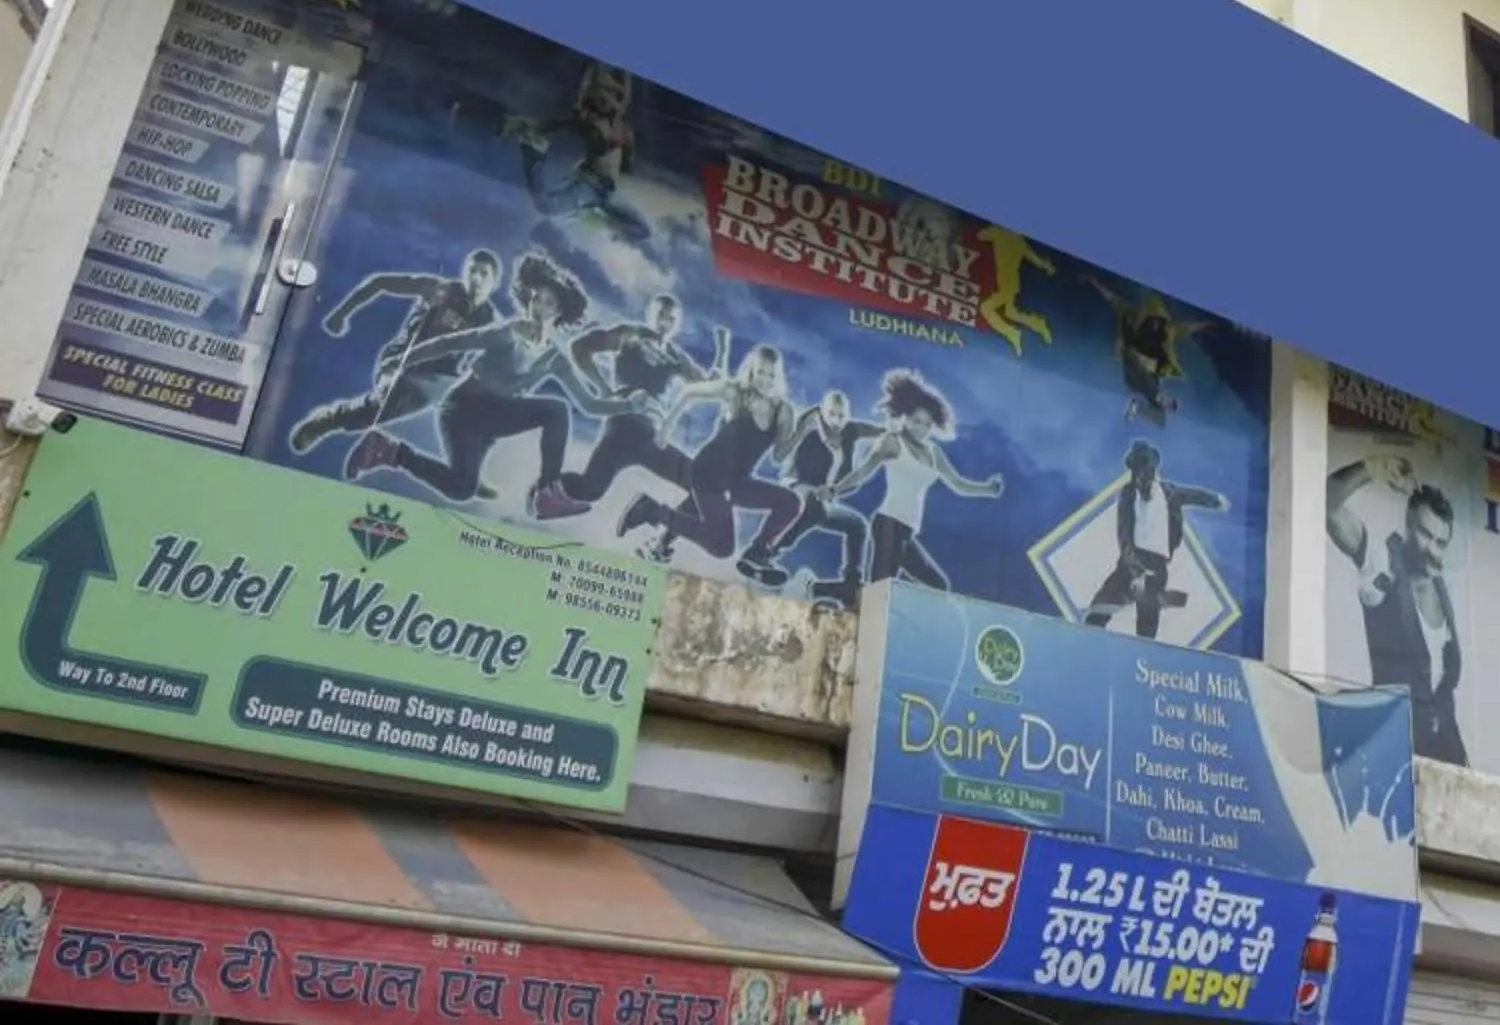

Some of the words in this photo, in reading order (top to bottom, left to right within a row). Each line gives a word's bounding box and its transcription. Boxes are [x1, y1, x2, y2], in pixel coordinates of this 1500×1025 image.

[124, 160, 182, 193] DANCING
[185, 177, 221, 204] SALSA
[113, 195, 171, 226] WESTERN
[167, 213, 215, 240] DANCE
[722, 153, 981, 279] BROADWAY
[101, 230, 131, 254] FREE
[130, 237, 168, 264] STYLE
[714, 211, 978, 327] INSTITUTE
[718, 186, 983, 307] DANCE
[88, 268, 138, 294] MASALA
[138, 279, 201, 312] BHANGRA
[73, 302, 127, 331] SPECIAL
[126, 318, 187, 351] AEROBICS
[187, 335, 199, 352] &
[199, 336, 247, 363] ZUMBA
[849, 307, 965, 348] LUDHIANA
[62, 345, 128, 374] SPECIAL
[132, 361, 194, 389] FITNESS
[195, 379, 244, 403] CLASS
[102, 374, 136, 394] FOR
[140, 383, 195, 408] LADIES
[137, 533, 294, 615] Hotel
[317, 572, 528, 676] Welcome
[550, 627, 629, 702] Inn
[58, 660, 92, 686] Way
[96, 667, 113, 686] To
[117, 671, 148, 693] 2nd
[149, 677, 188, 700] Floor
[1134, 657, 1200, 694] Special
[317, 679, 400, 714] Premium
[404, 695, 454, 726] Stays
[458, 706, 517, 738] Deluxe
[522, 723, 556, 745] and
[1154, 693, 1187, 720] Cow
[244, 696, 305, 728] Super
[307, 708, 372, 740] Deluxe
[376, 721, 437, 753] Rooms
[440, 734, 480, 761] Also
[483, 741, 554, 777] Booking
[557, 755, 602, 783] Here.
[1152, 725, 1185, 751] Desi
[1145, 816, 1194, 845] Chatti
[1200, 823, 1240, 851] Lassi
[55, 926, 207, 1009] कल्लू
[217, 928, 280, 998] टी
[293, 953, 424, 1013] स्टाल
[1033, 945, 1107, 991] 300
[1110, 957, 1156, 998] ML
[1162, 964, 1252, 1010] PEPSI
